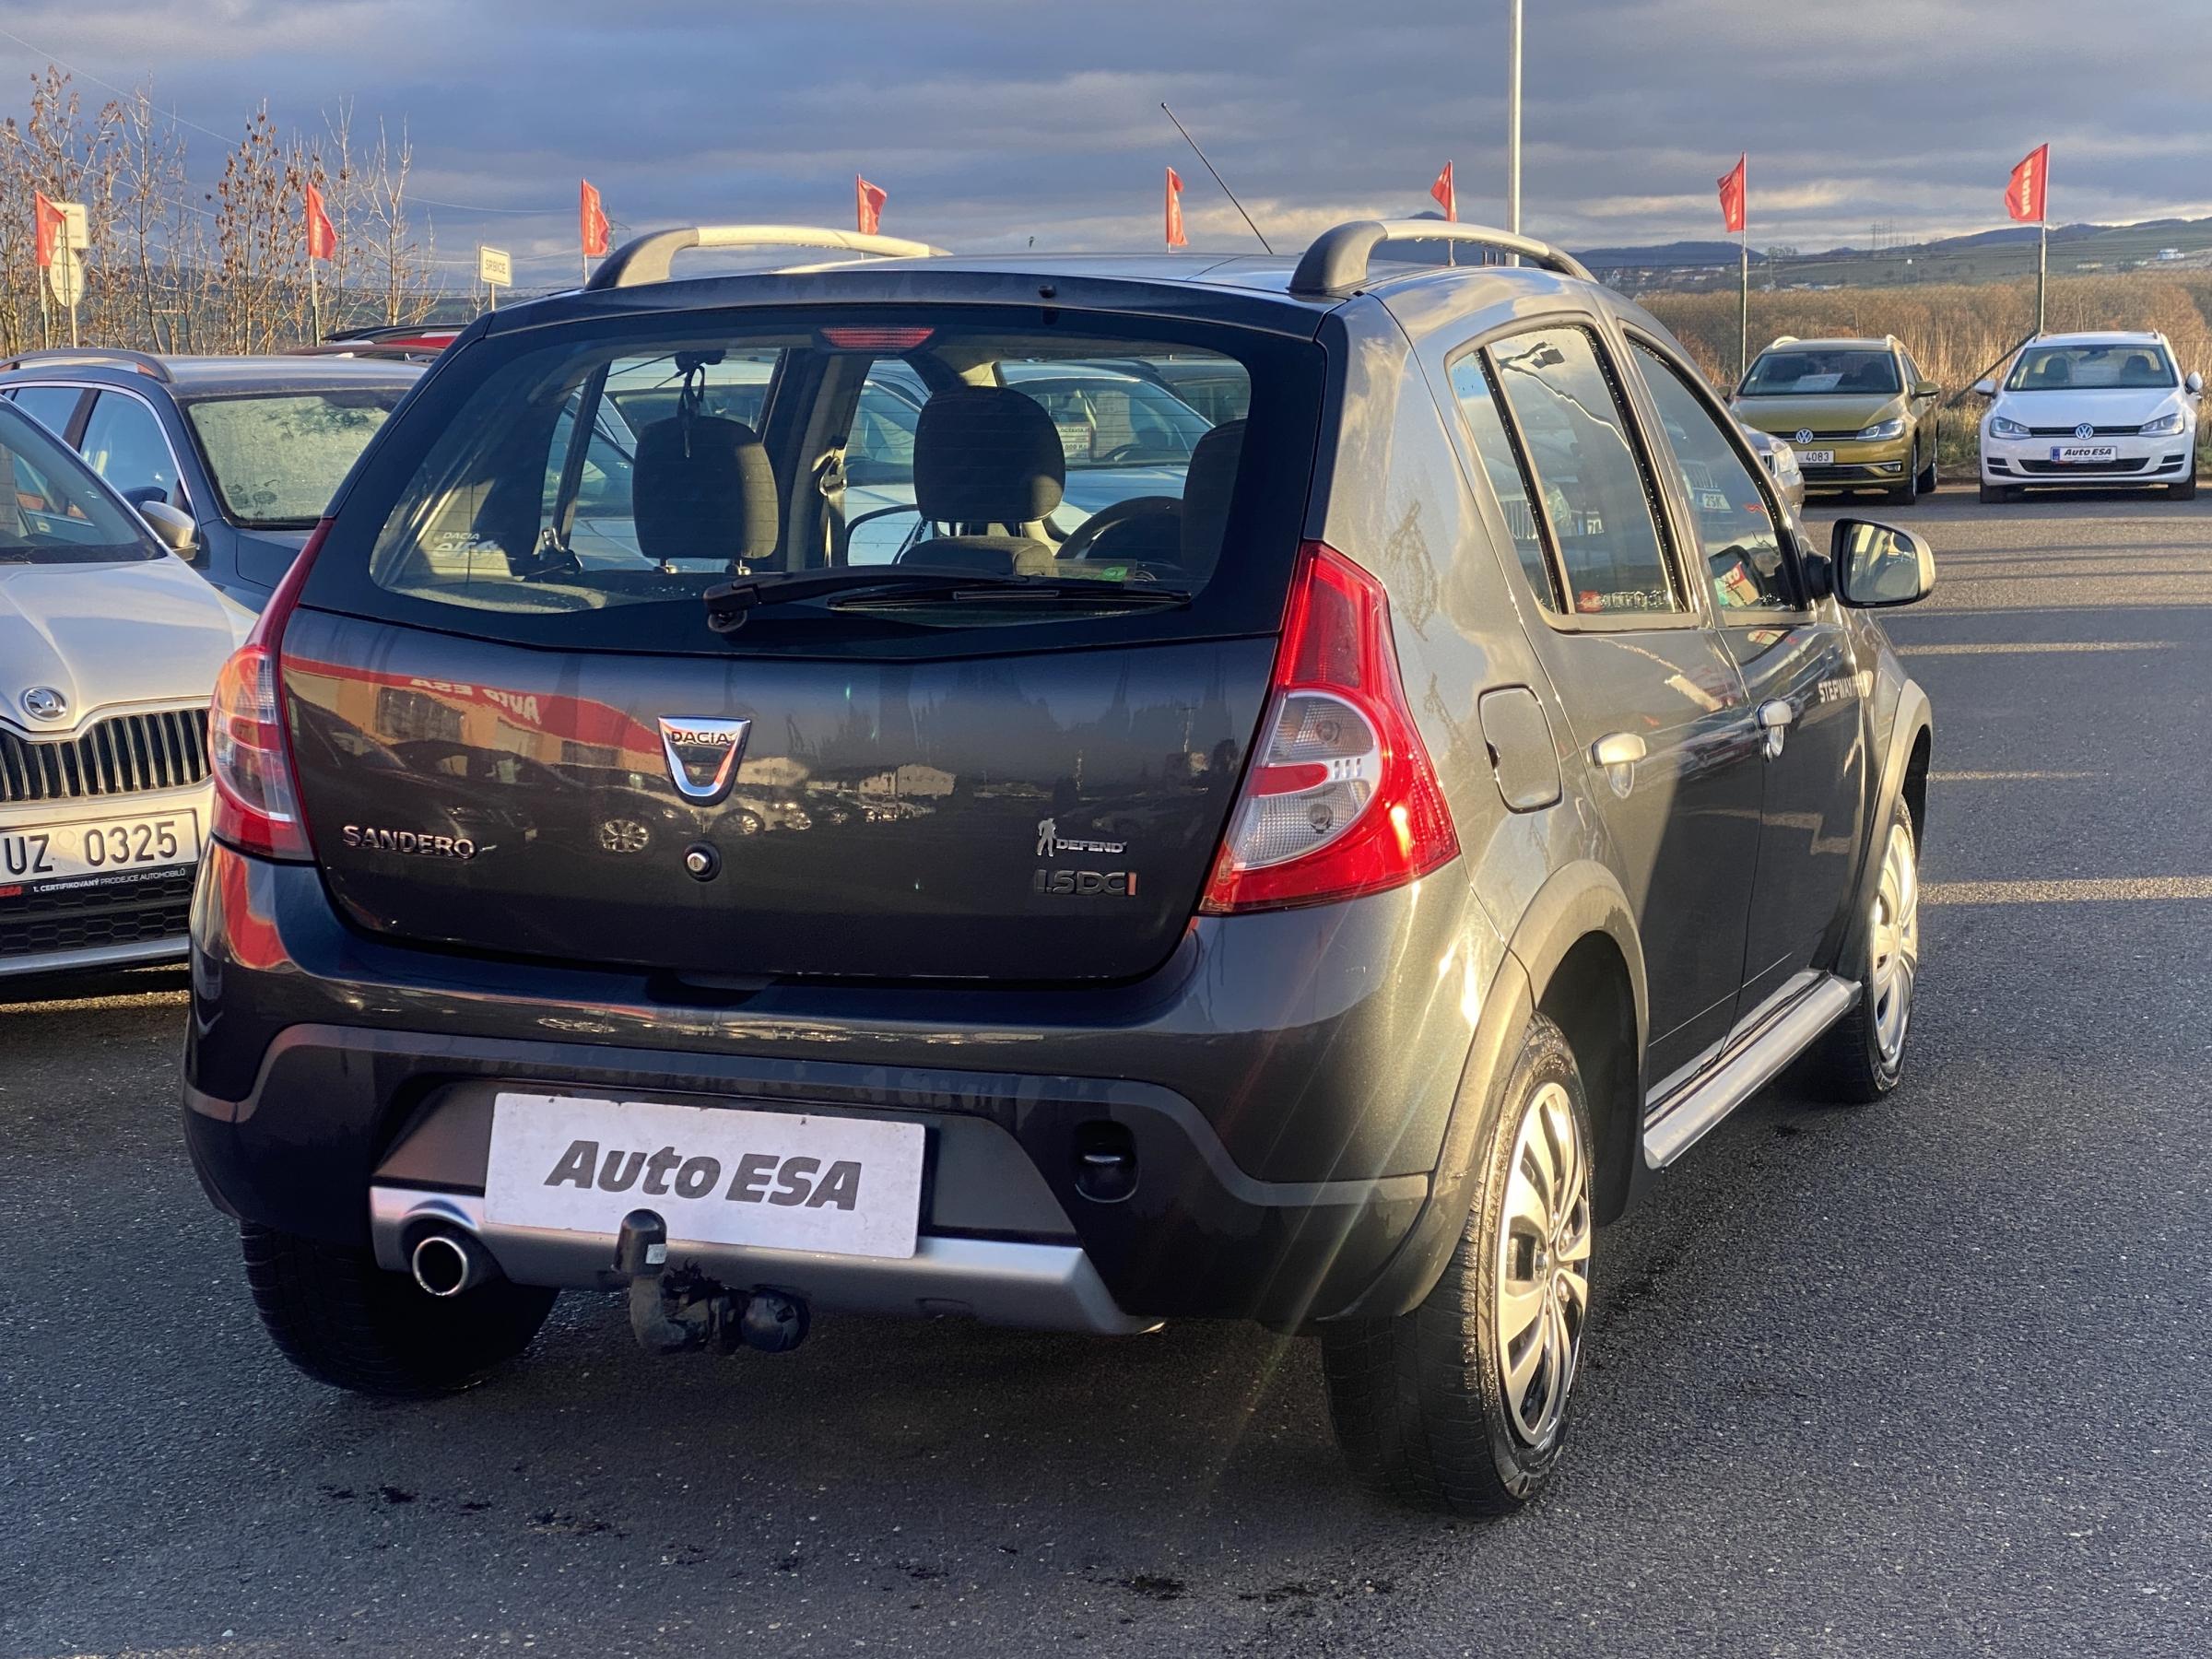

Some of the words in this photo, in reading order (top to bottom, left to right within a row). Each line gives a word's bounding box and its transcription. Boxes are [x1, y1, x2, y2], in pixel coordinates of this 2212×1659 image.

[485, 259, 507, 275] SRBICE
[1806, 452, 1830, 462] 4083
[2064, 448, 2091, 456] Auto
[2091, 448, 2112, 456] ESA
[442, 532, 479, 541] DACIA
[670, 731, 731, 745] DACIA
[4, 834, 53, 875] UZ
[84, 820, 178, 867] 0325
[342, 825, 475, 859] SANDERO
[1055, 838, 1124, 853] DEFEND
[40, 877, 100, 892] CERTIFIKOVANÝ
[100, 874, 139, 886] PRODEJCE
[140, 867, 186, 881] AUTOMOBILŮ
[544, 1140, 721, 1199] Auto
[725, 1153, 863, 1211] ESA
